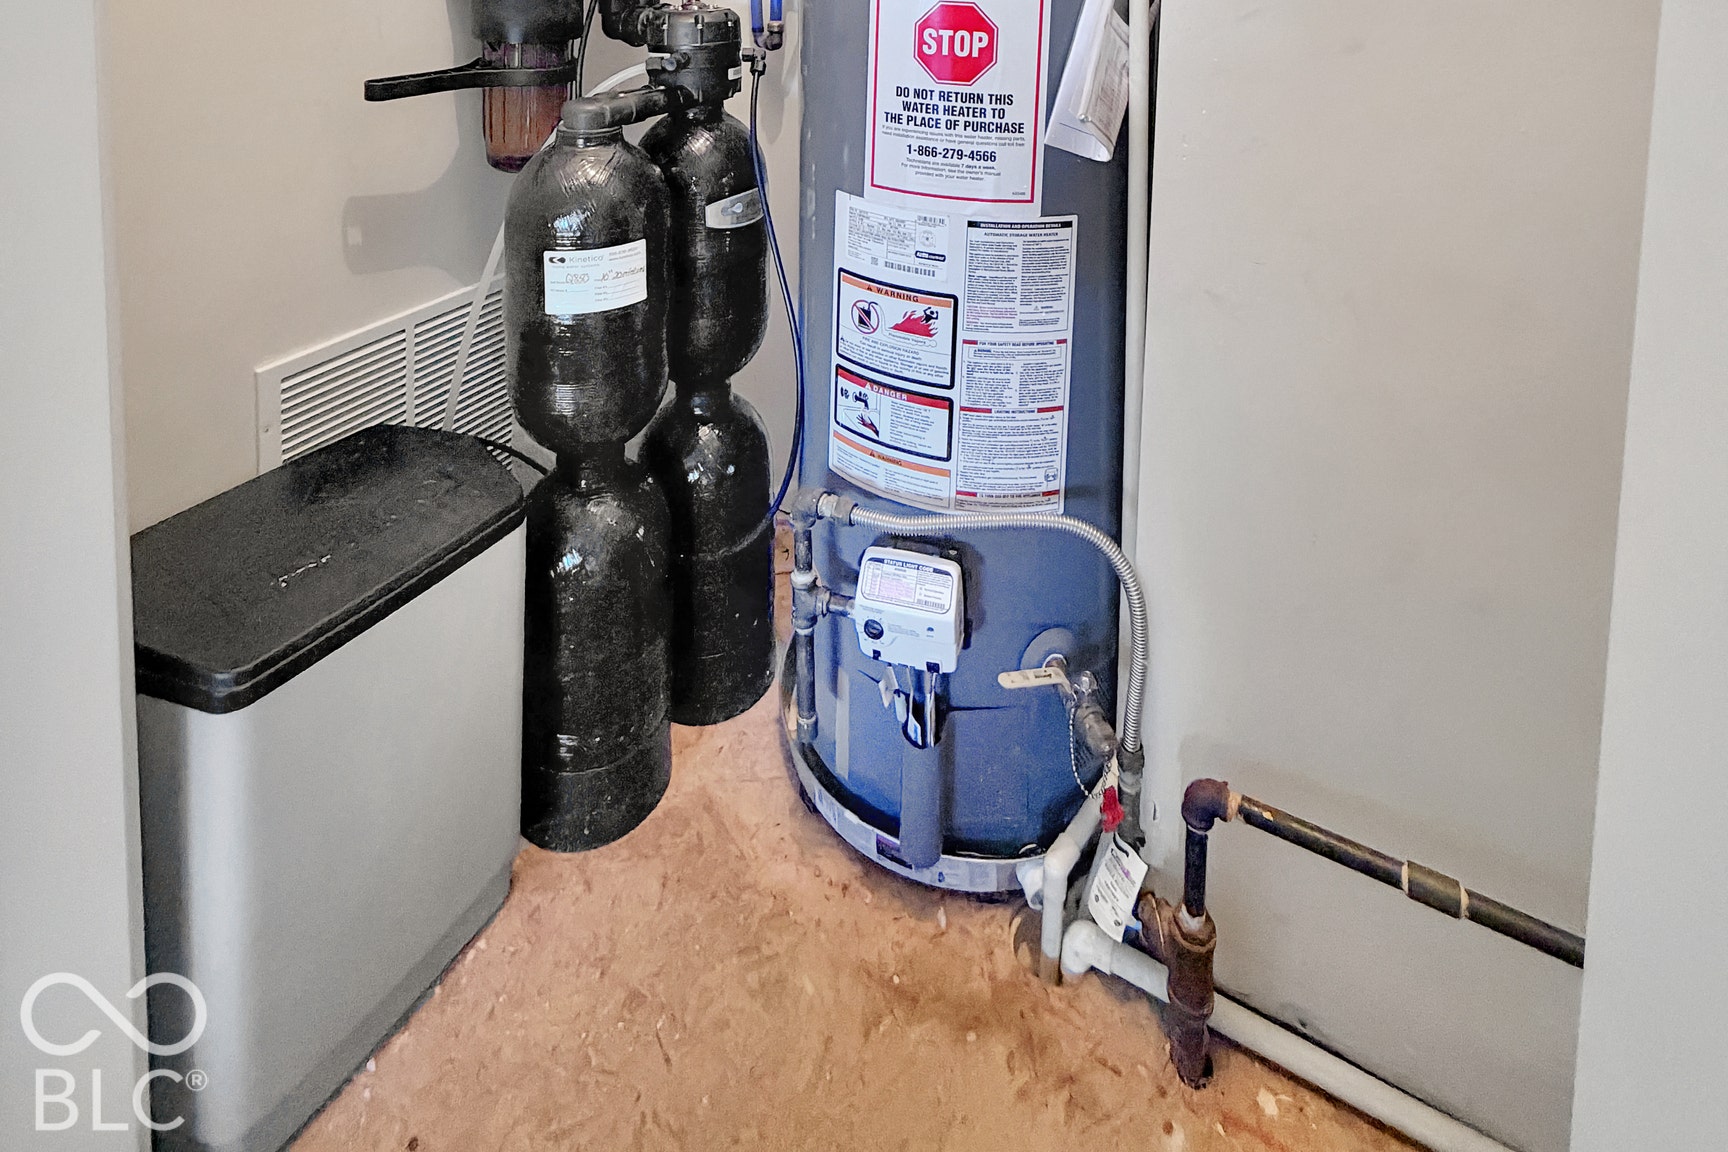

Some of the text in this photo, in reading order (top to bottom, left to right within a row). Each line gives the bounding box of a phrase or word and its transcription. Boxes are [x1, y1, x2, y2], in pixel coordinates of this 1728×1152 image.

[922, 28, 988, 58] STOP
[896, 86, 1014, 106] DO NOT RETURN THIS
[902, 100, 1006, 120] WATER HEATER TO
[884, 112, 1025, 134] THE PLACE OF PURCHASE
[890, 132, 914, 140] installation
[916, 134, 938, 142] assistance
[957, 138, 974, 146] general
[902, 128, 928, 136] experiencing
[906, 144, 996, 162] 1-866-279-4566
[906, 157, 931, 166] Technicians
[568, 255, 604, 264] Kinetico
[876, 286, 919, 302] WARNING
[873, 384, 908, 401] DANGER
[903, 561, 918, 569] LIGHT
